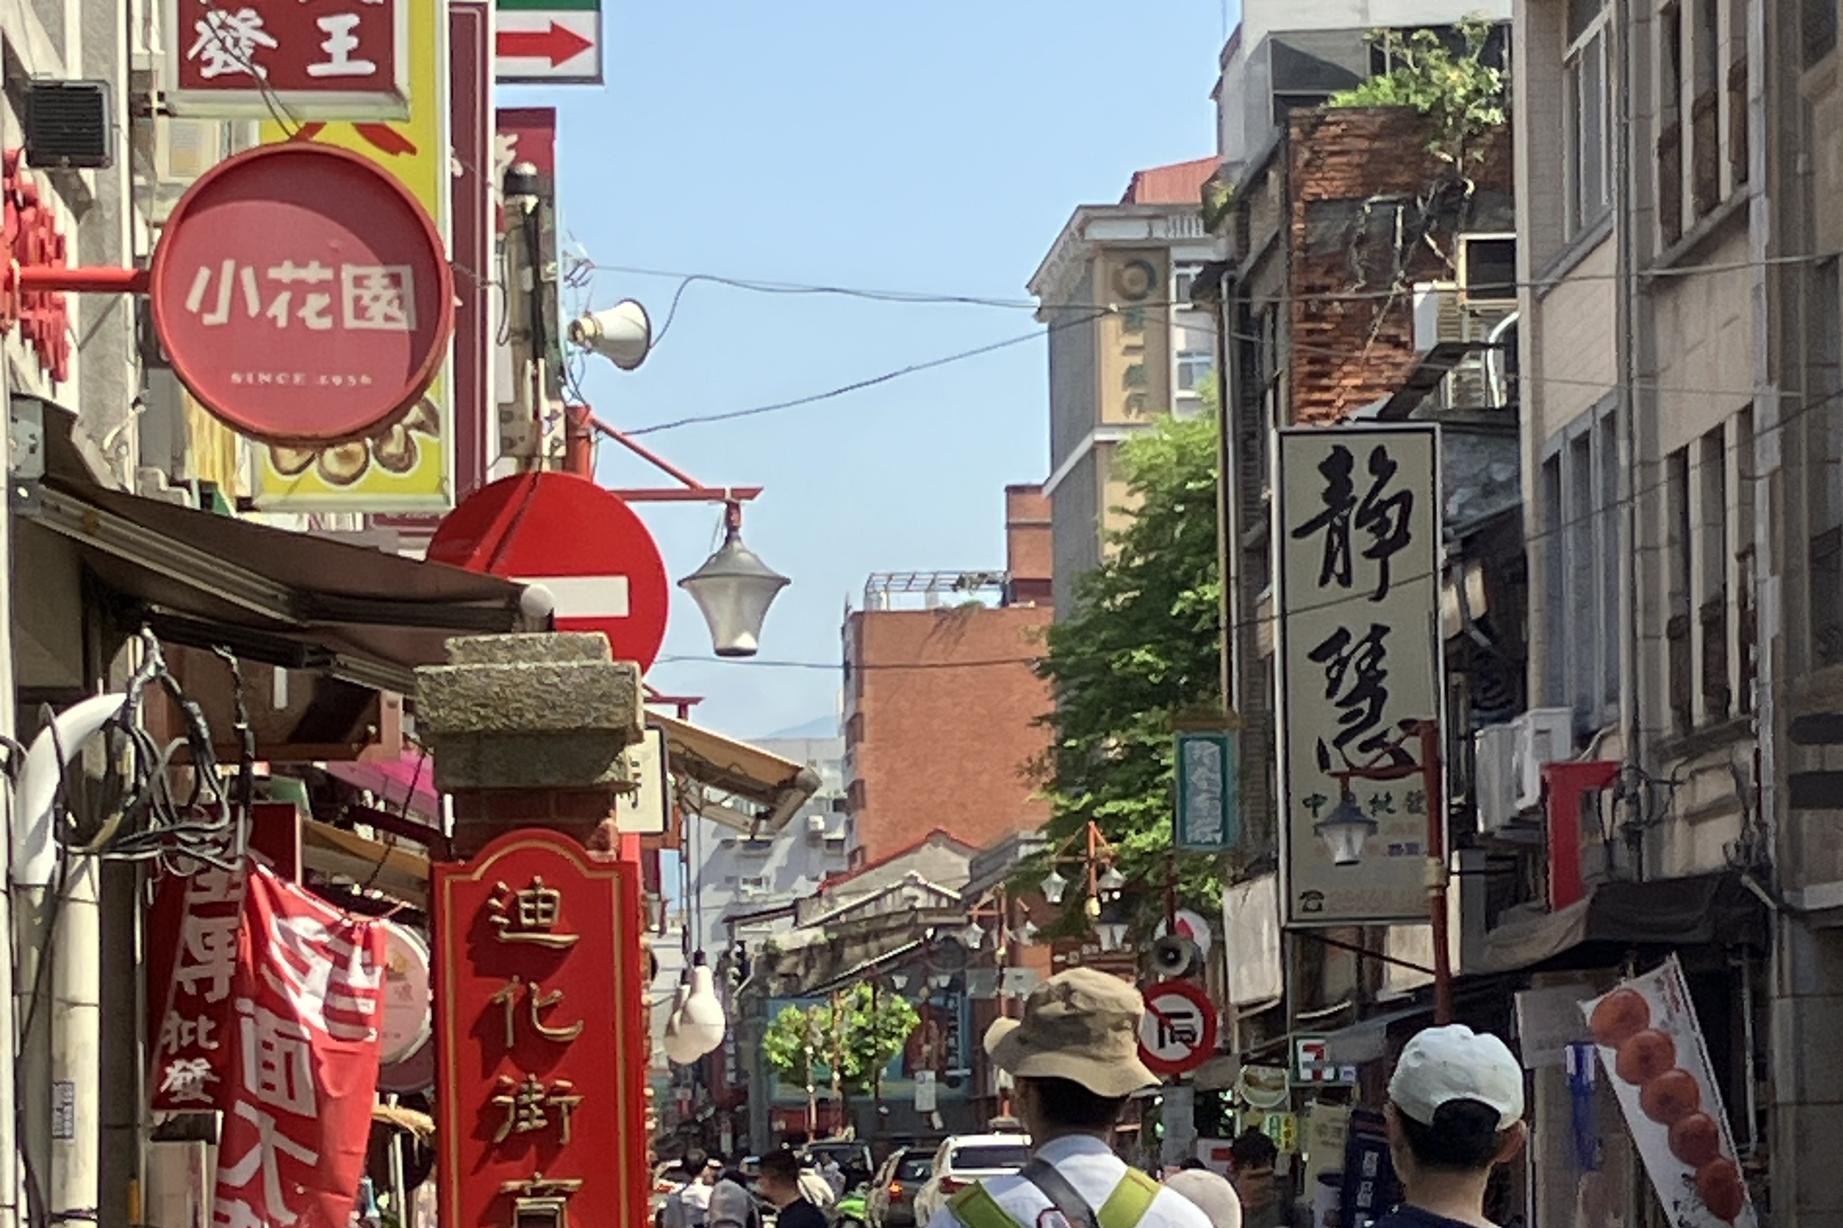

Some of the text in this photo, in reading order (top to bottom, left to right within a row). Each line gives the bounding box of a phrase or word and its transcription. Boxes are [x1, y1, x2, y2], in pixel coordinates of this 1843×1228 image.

[185, 259, 417, 331] 小花園
[230, 371, 306, 387] SINCE
